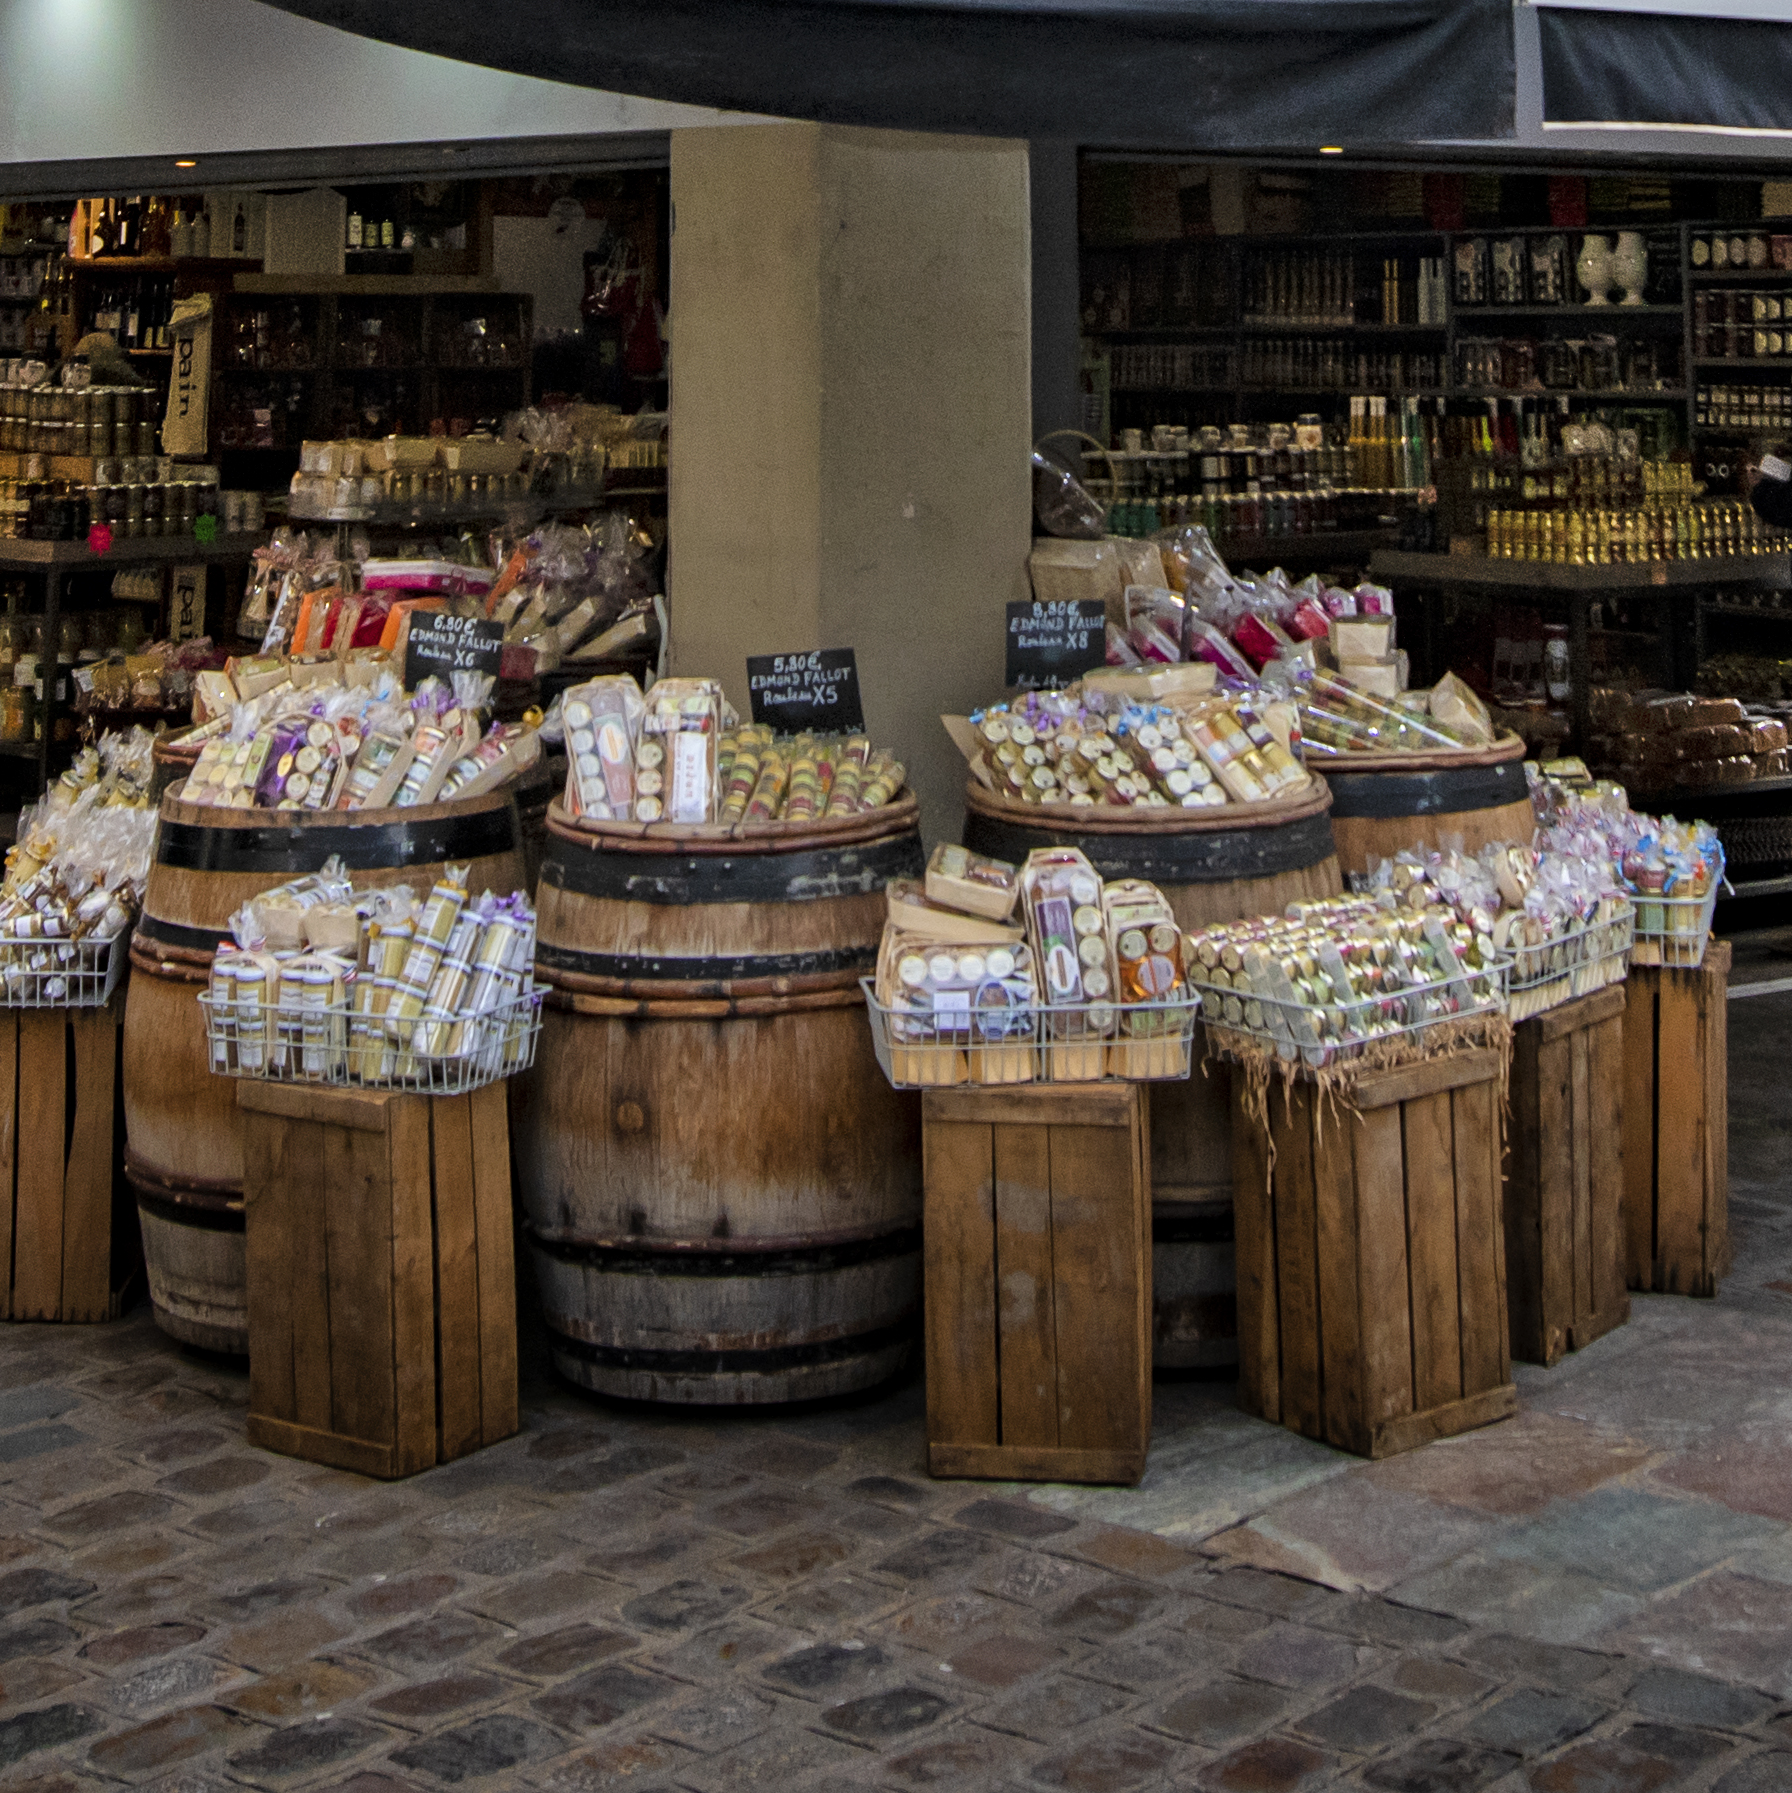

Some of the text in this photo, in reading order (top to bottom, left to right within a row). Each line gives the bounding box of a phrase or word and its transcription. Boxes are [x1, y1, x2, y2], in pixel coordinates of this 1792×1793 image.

[178, 337, 197, 417] pain
[177, 585, 198, 640] pai
[409, 627, 503, 654] EDMOND FALLOT
[1066, 630, 1088, 650] X8
[453, 648, 476, 667] X6
[750, 666, 851, 690] EDMOND FALLOT
[812, 684, 838, 708] X5
